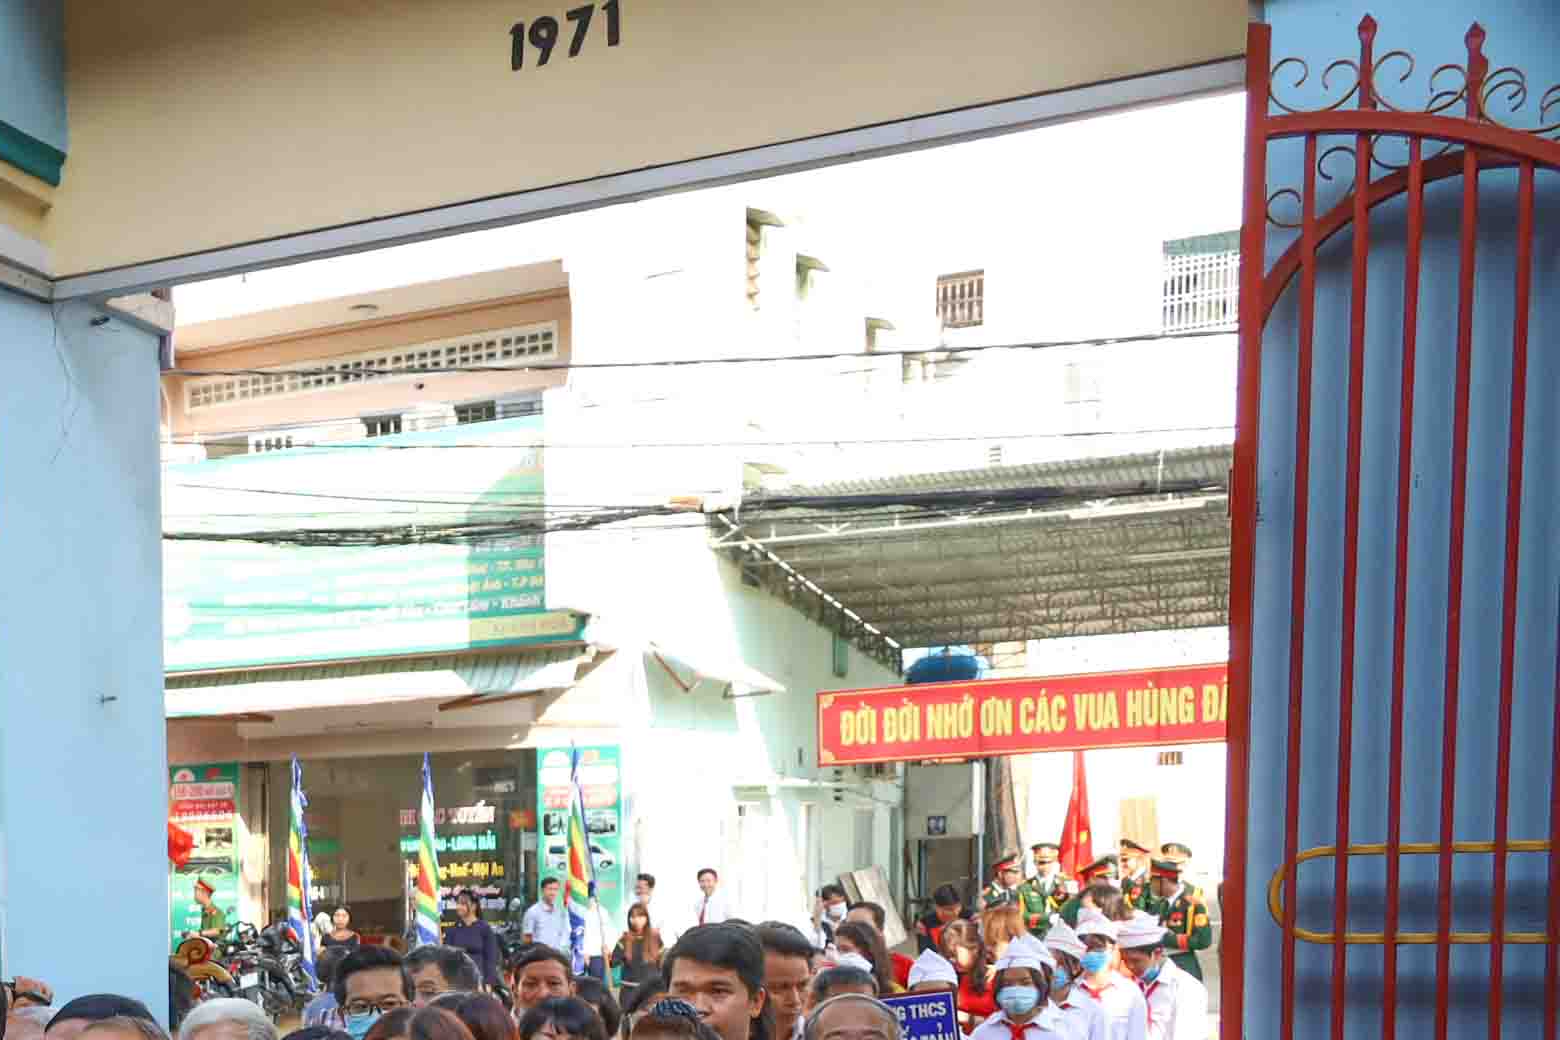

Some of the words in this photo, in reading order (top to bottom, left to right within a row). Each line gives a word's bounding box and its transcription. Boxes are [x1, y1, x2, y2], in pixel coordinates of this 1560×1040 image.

[509, 0, 620, 71] 1971
[840, 702, 877, 746] ĐỜI
[883, 698, 920, 743] ĐỜI
[926, 694, 974, 740] NHỚ
[980, 696, 1012, 737] ƠN
[1020, 689, 1067, 734] CÁC
[1074, 691, 1120, 731] VUA
[1126, 680, 1195, 727] HÙNG
[908, 1001, 947, 1020] THCS
